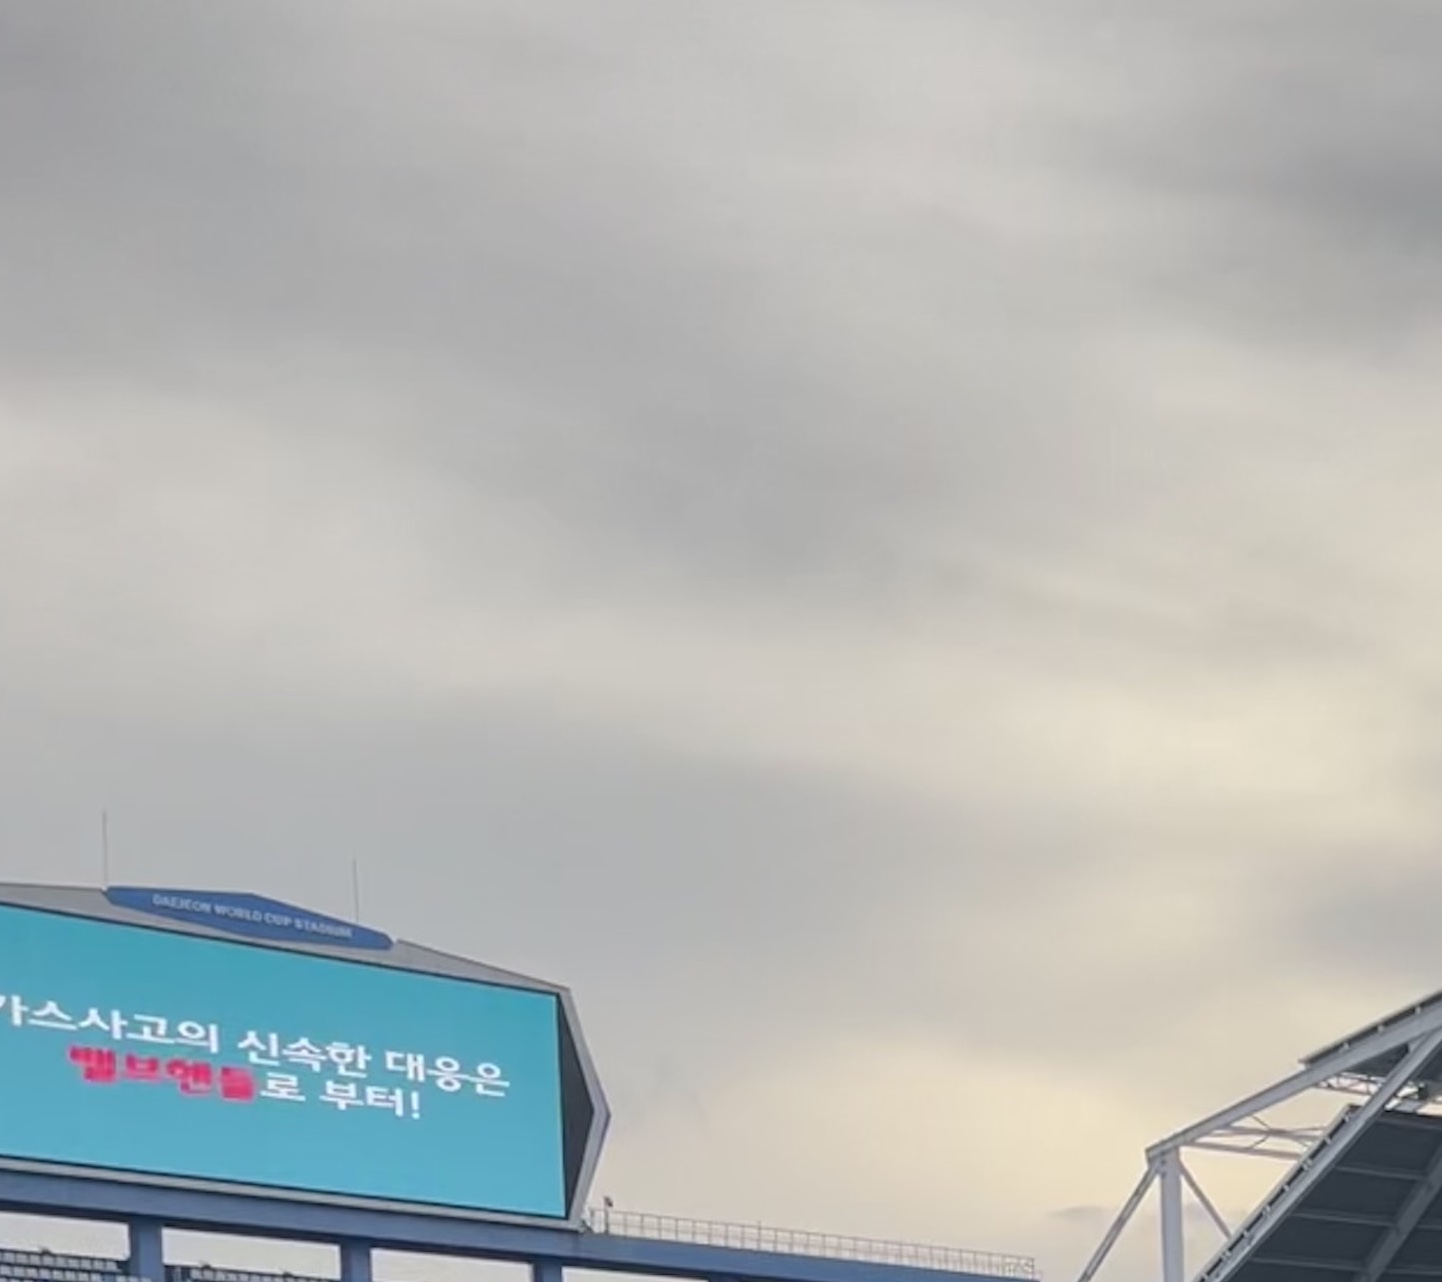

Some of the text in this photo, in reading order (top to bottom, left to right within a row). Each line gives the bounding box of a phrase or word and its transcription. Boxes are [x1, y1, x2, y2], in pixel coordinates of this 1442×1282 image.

[214, 902, 263, 922] WORLD
[263, 911, 291, 926] CUP
[294, 917, 353, 938] STADIUM
[237, 1030, 373, 1079] 신속한
[384, 1050, 511, 1098] 대응은
[319, 1079, 420, 1120] 부터!
